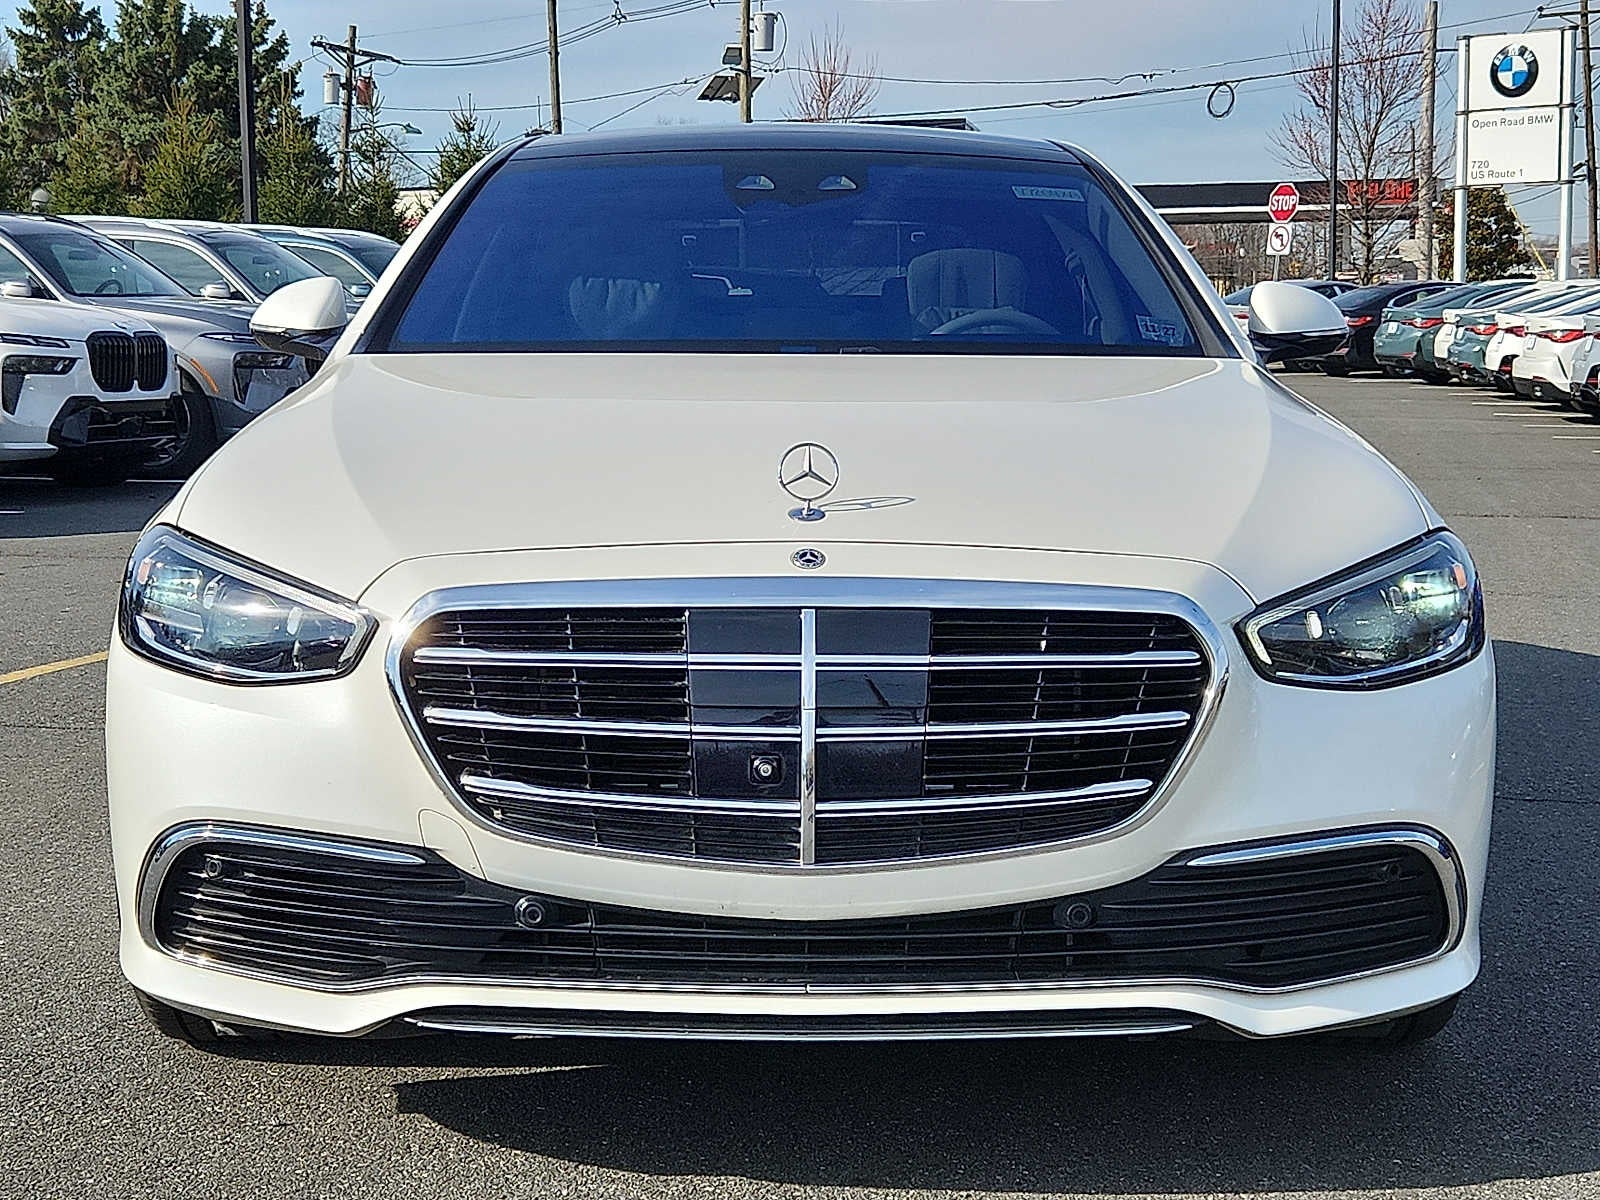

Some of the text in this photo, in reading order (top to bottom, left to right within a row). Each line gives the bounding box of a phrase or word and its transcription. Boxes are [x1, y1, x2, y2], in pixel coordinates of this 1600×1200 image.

[1494, 45, 1535, 65] BMW
[1472, 114, 1554, 130] Open Road BMW
[1471, 160, 1490, 169] 720
[1471, 168, 1524, 179] US Route 1
[1271, 194, 1296, 212] STOP
